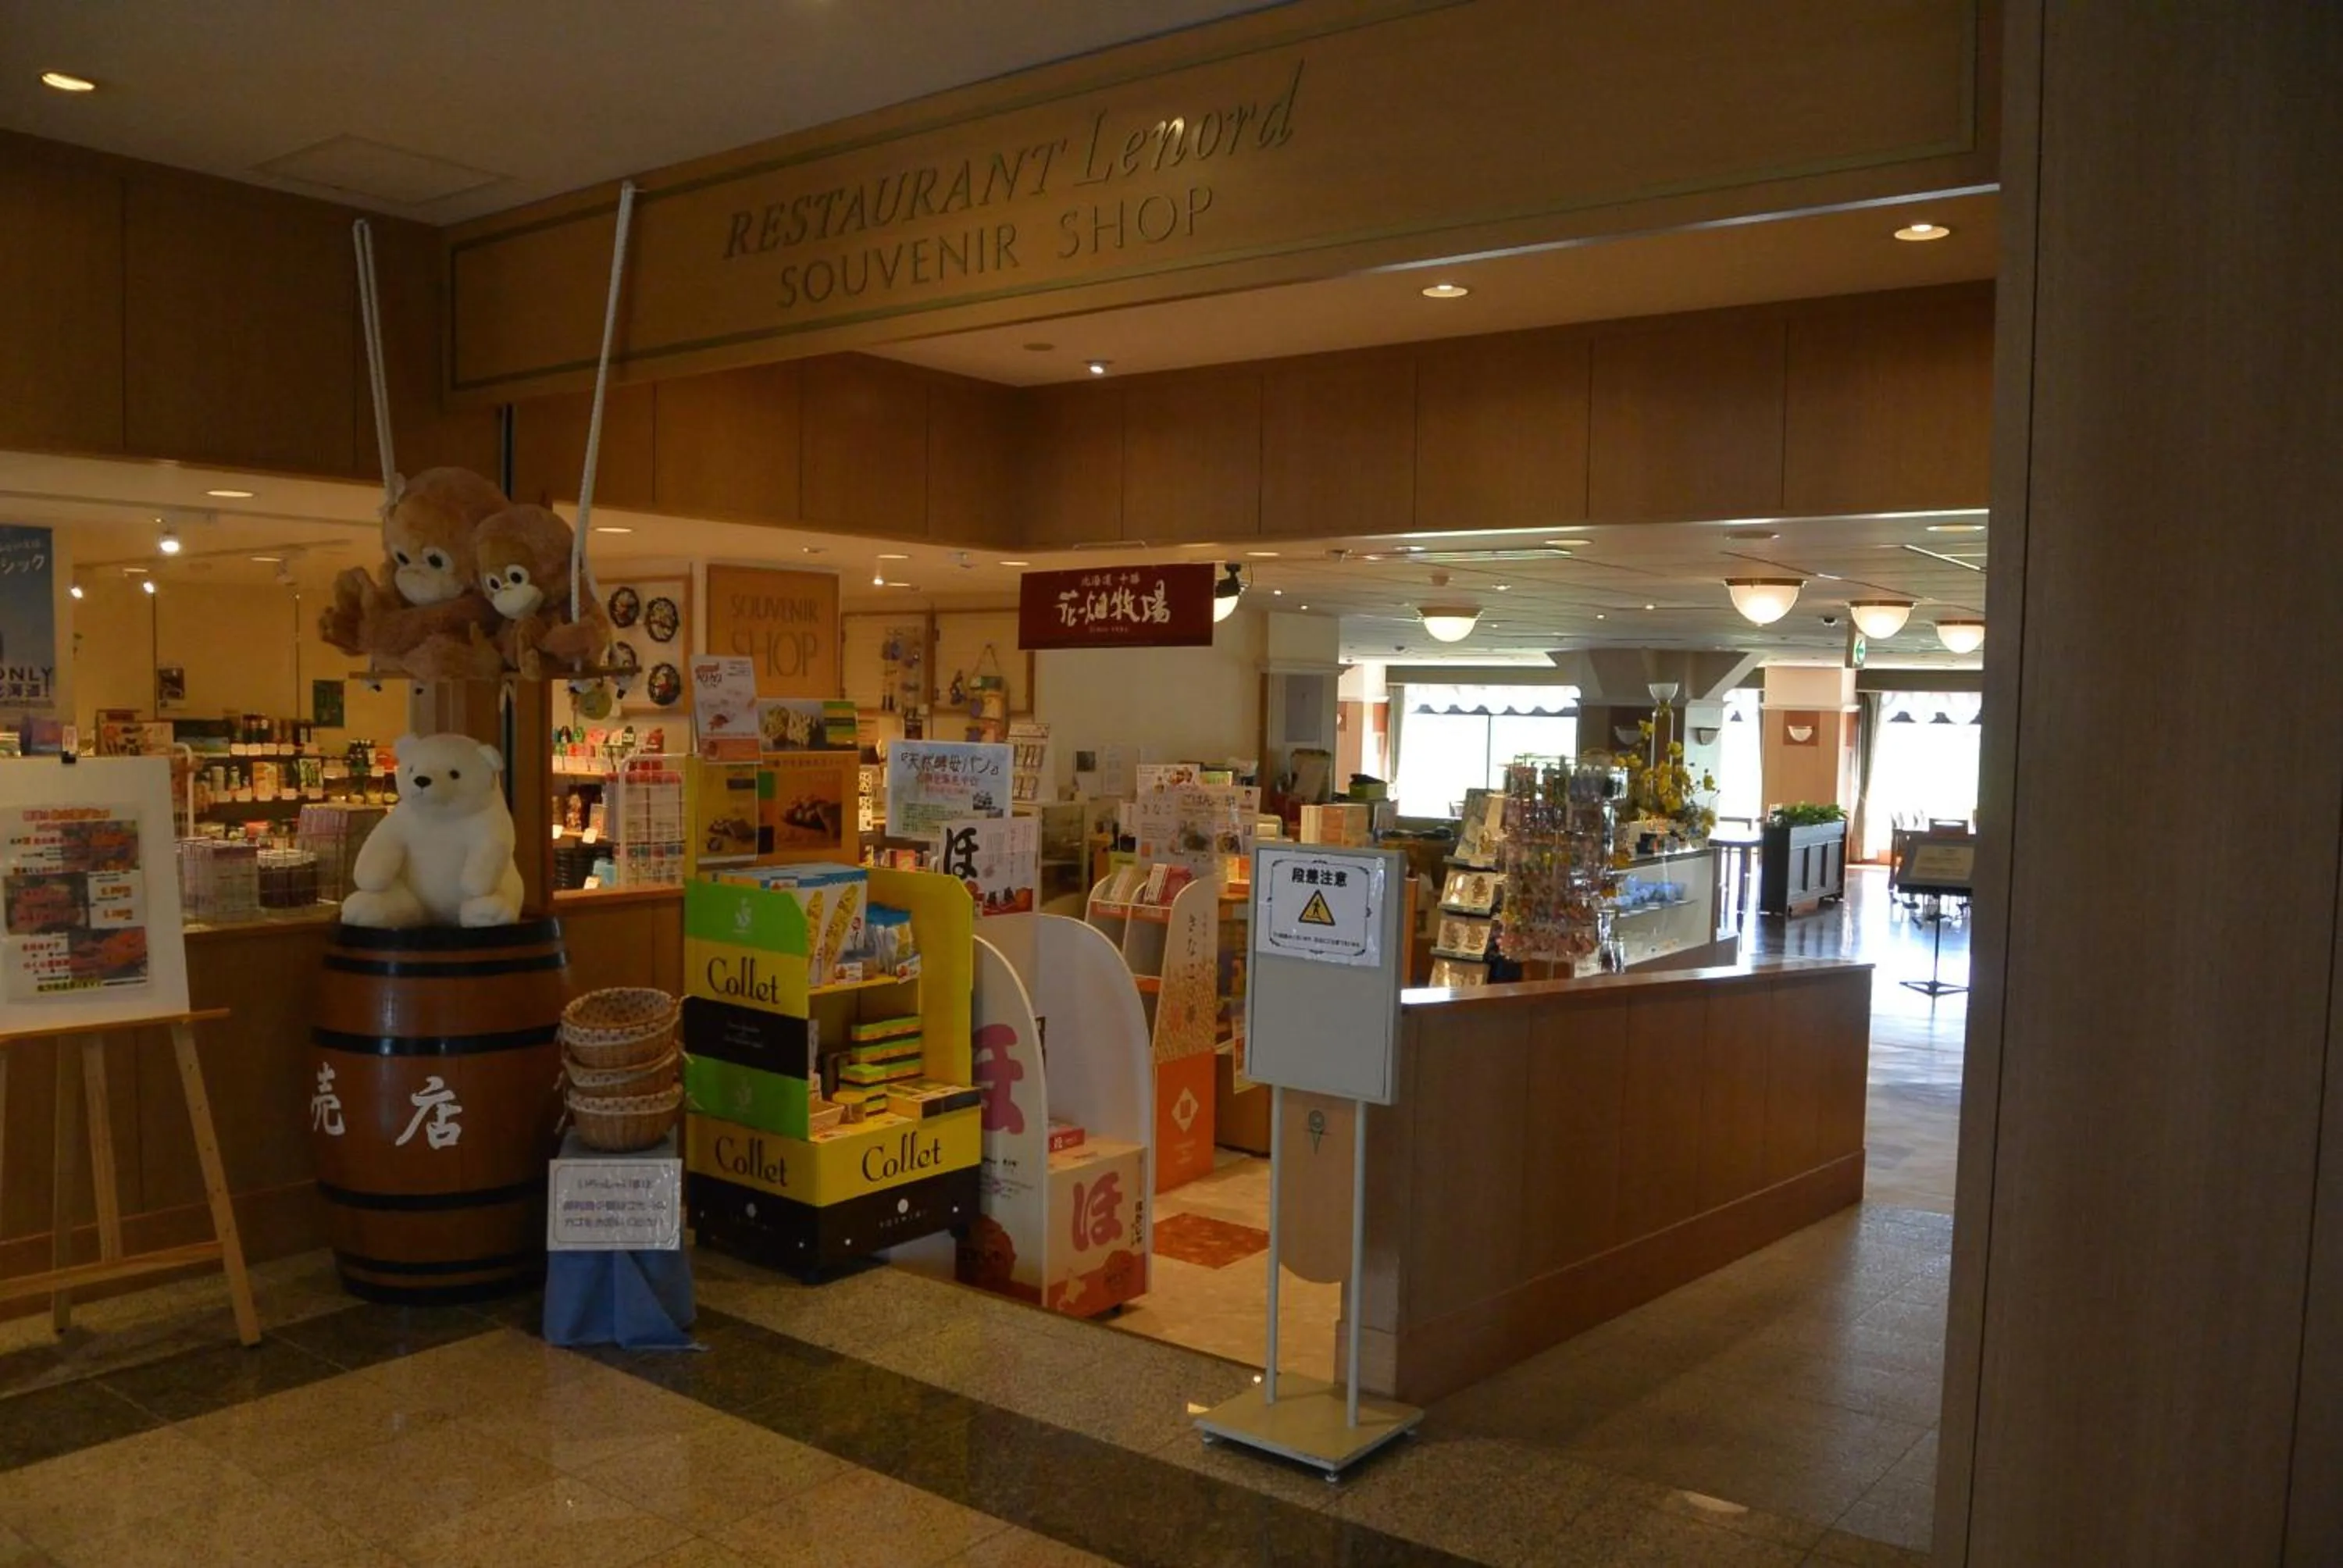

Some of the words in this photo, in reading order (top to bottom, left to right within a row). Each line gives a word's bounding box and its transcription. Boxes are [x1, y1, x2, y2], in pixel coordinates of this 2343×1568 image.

[722, 137, 1068, 259] RESTAURANT
[1074, 58, 1306, 187] Lenord
[777, 223, 1020, 309] SOUVENIR
[1057, 185, 1214, 258] SHOP
[731, 593, 819, 623] SOUVENIR
[1056, 579, 1170, 626] 花畑牧場
[943, 827, 979, 880] ほ
[1292, 868, 1348, 887] 段差注意
[708, 957, 779, 1005] Collet
[715, 1136, 788, 1188] Collet
[861, 1131, 942, 1183] Collet
[1072, 1172, 1122, 1252] ほ
